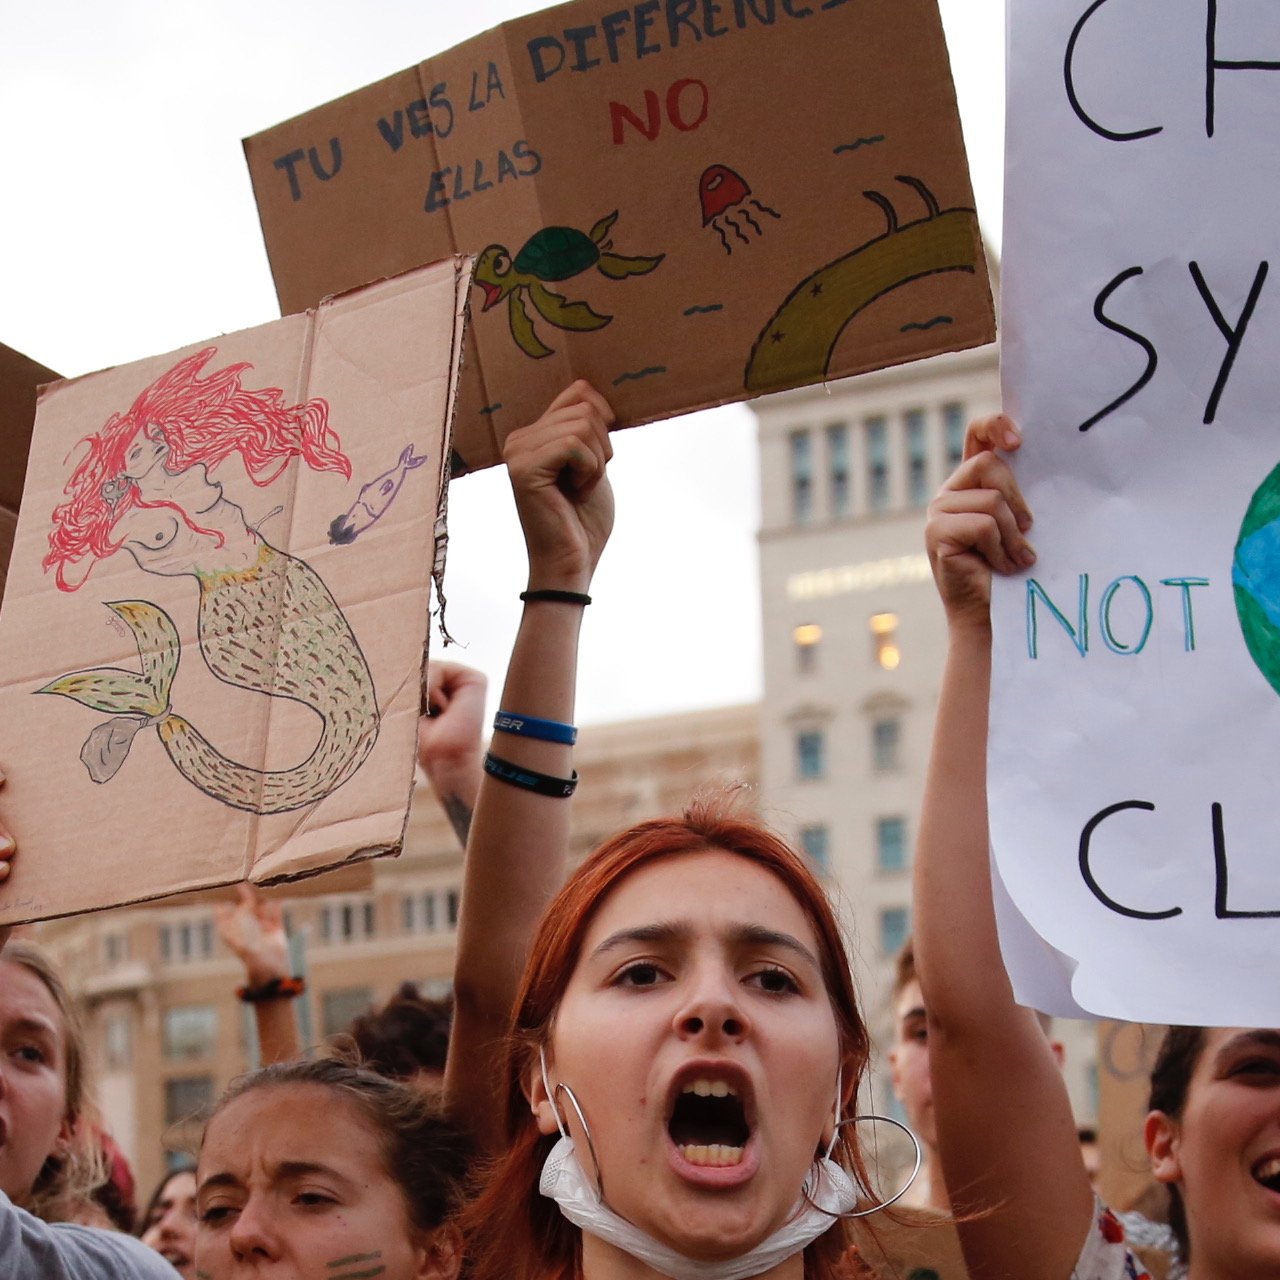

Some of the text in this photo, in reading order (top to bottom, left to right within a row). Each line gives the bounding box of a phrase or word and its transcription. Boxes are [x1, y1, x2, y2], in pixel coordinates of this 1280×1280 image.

[274, 0, 849, 201] TU VES LA DIFEREN
[424, 78, 709, 213] ELLAS NO
[1024, 572, 1211, 660] NOT
